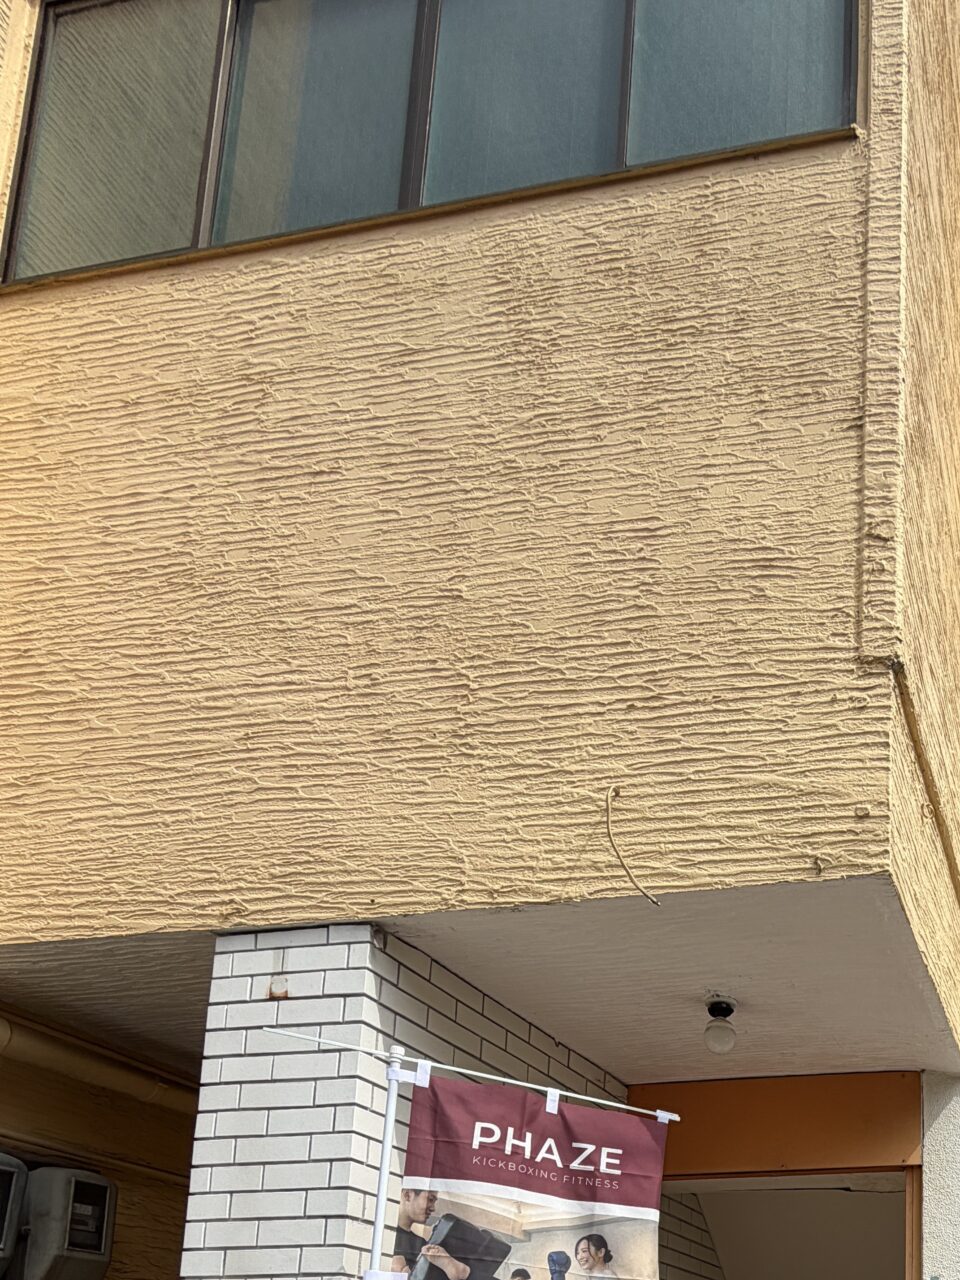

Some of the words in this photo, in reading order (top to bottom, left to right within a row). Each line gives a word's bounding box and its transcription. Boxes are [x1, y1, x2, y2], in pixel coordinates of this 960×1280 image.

[472, 1121, 623, 1176] PHAZE
[472, 1156, 558, 1181] KICKBOXING
[562, 1175, 620, 1190] FITNESS
